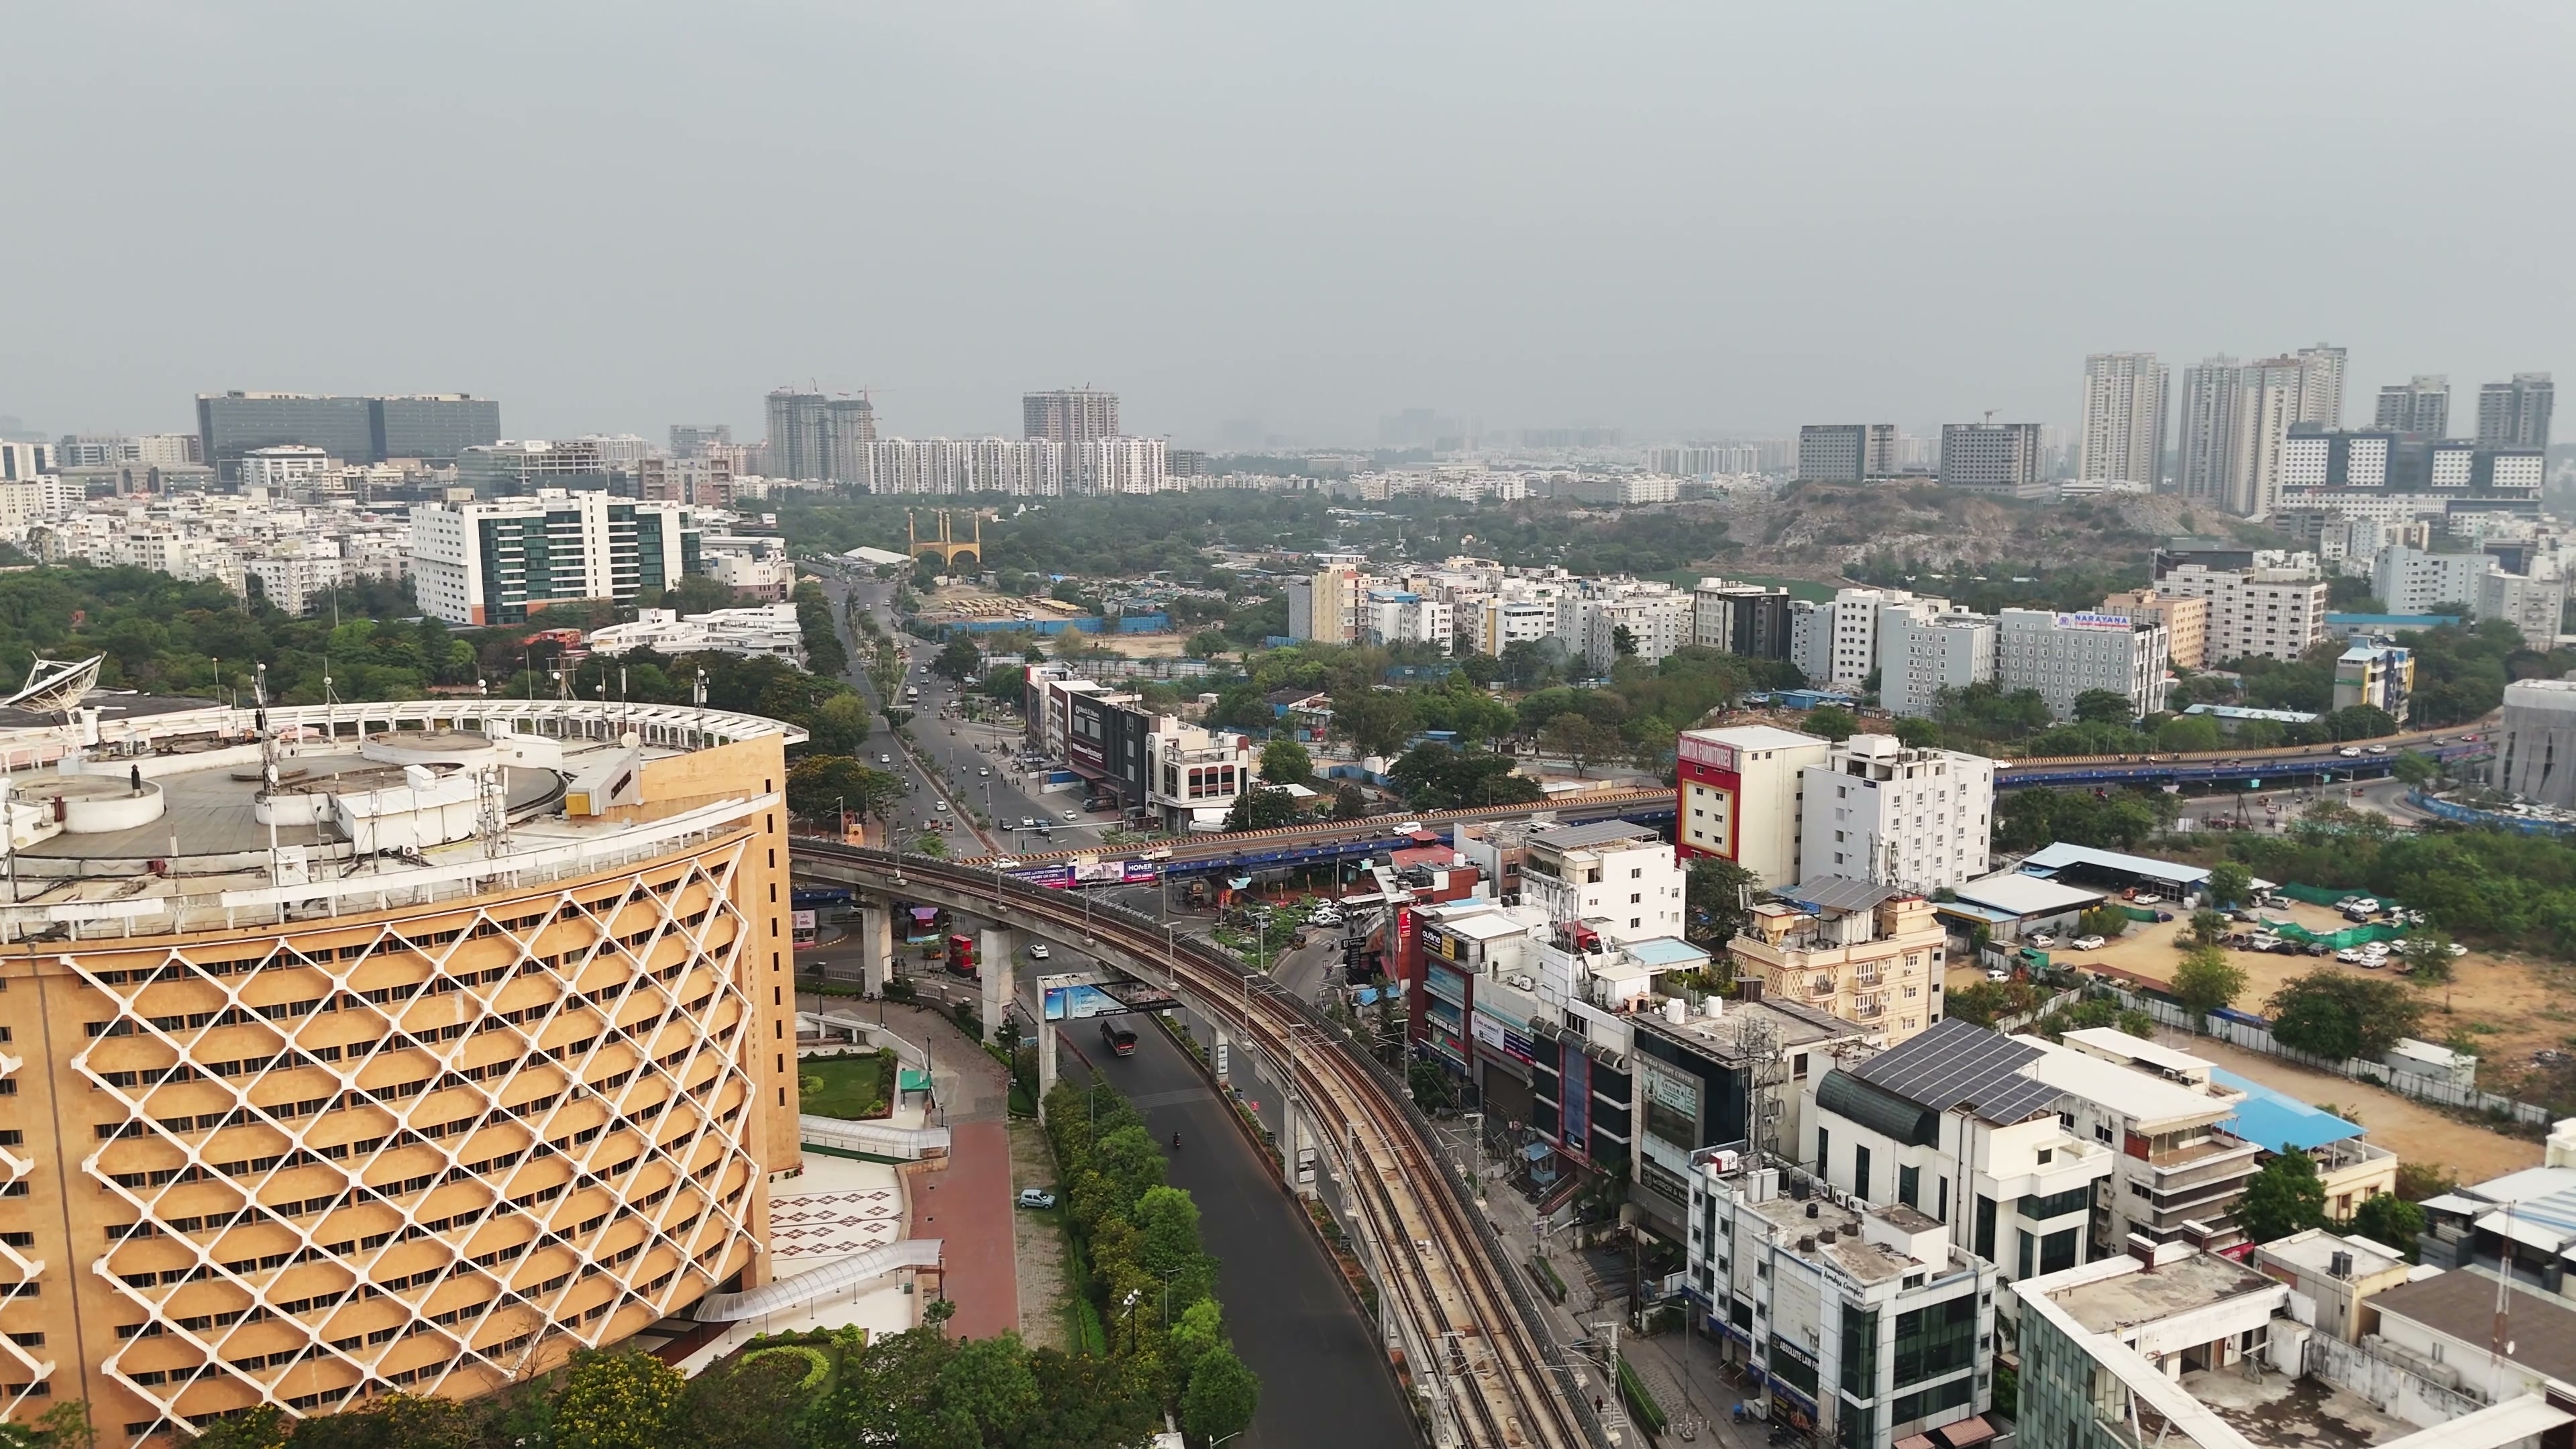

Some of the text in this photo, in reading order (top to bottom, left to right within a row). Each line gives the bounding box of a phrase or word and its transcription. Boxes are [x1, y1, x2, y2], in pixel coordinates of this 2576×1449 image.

[2075, 615, 2127, 623] NARAYANA
[1679, 739, 1731, 767] BANTIA FURNITURES
[1128, 863, 1152, 871] HONER
[1674, 1071, 1695, 1084] CENTRE
[1843, 1282, 1864, 1299] Complex
[1779, 1341, 1802, 1362] ABSOLUTE
[1801, 1353, 1812, 1368] LAW
